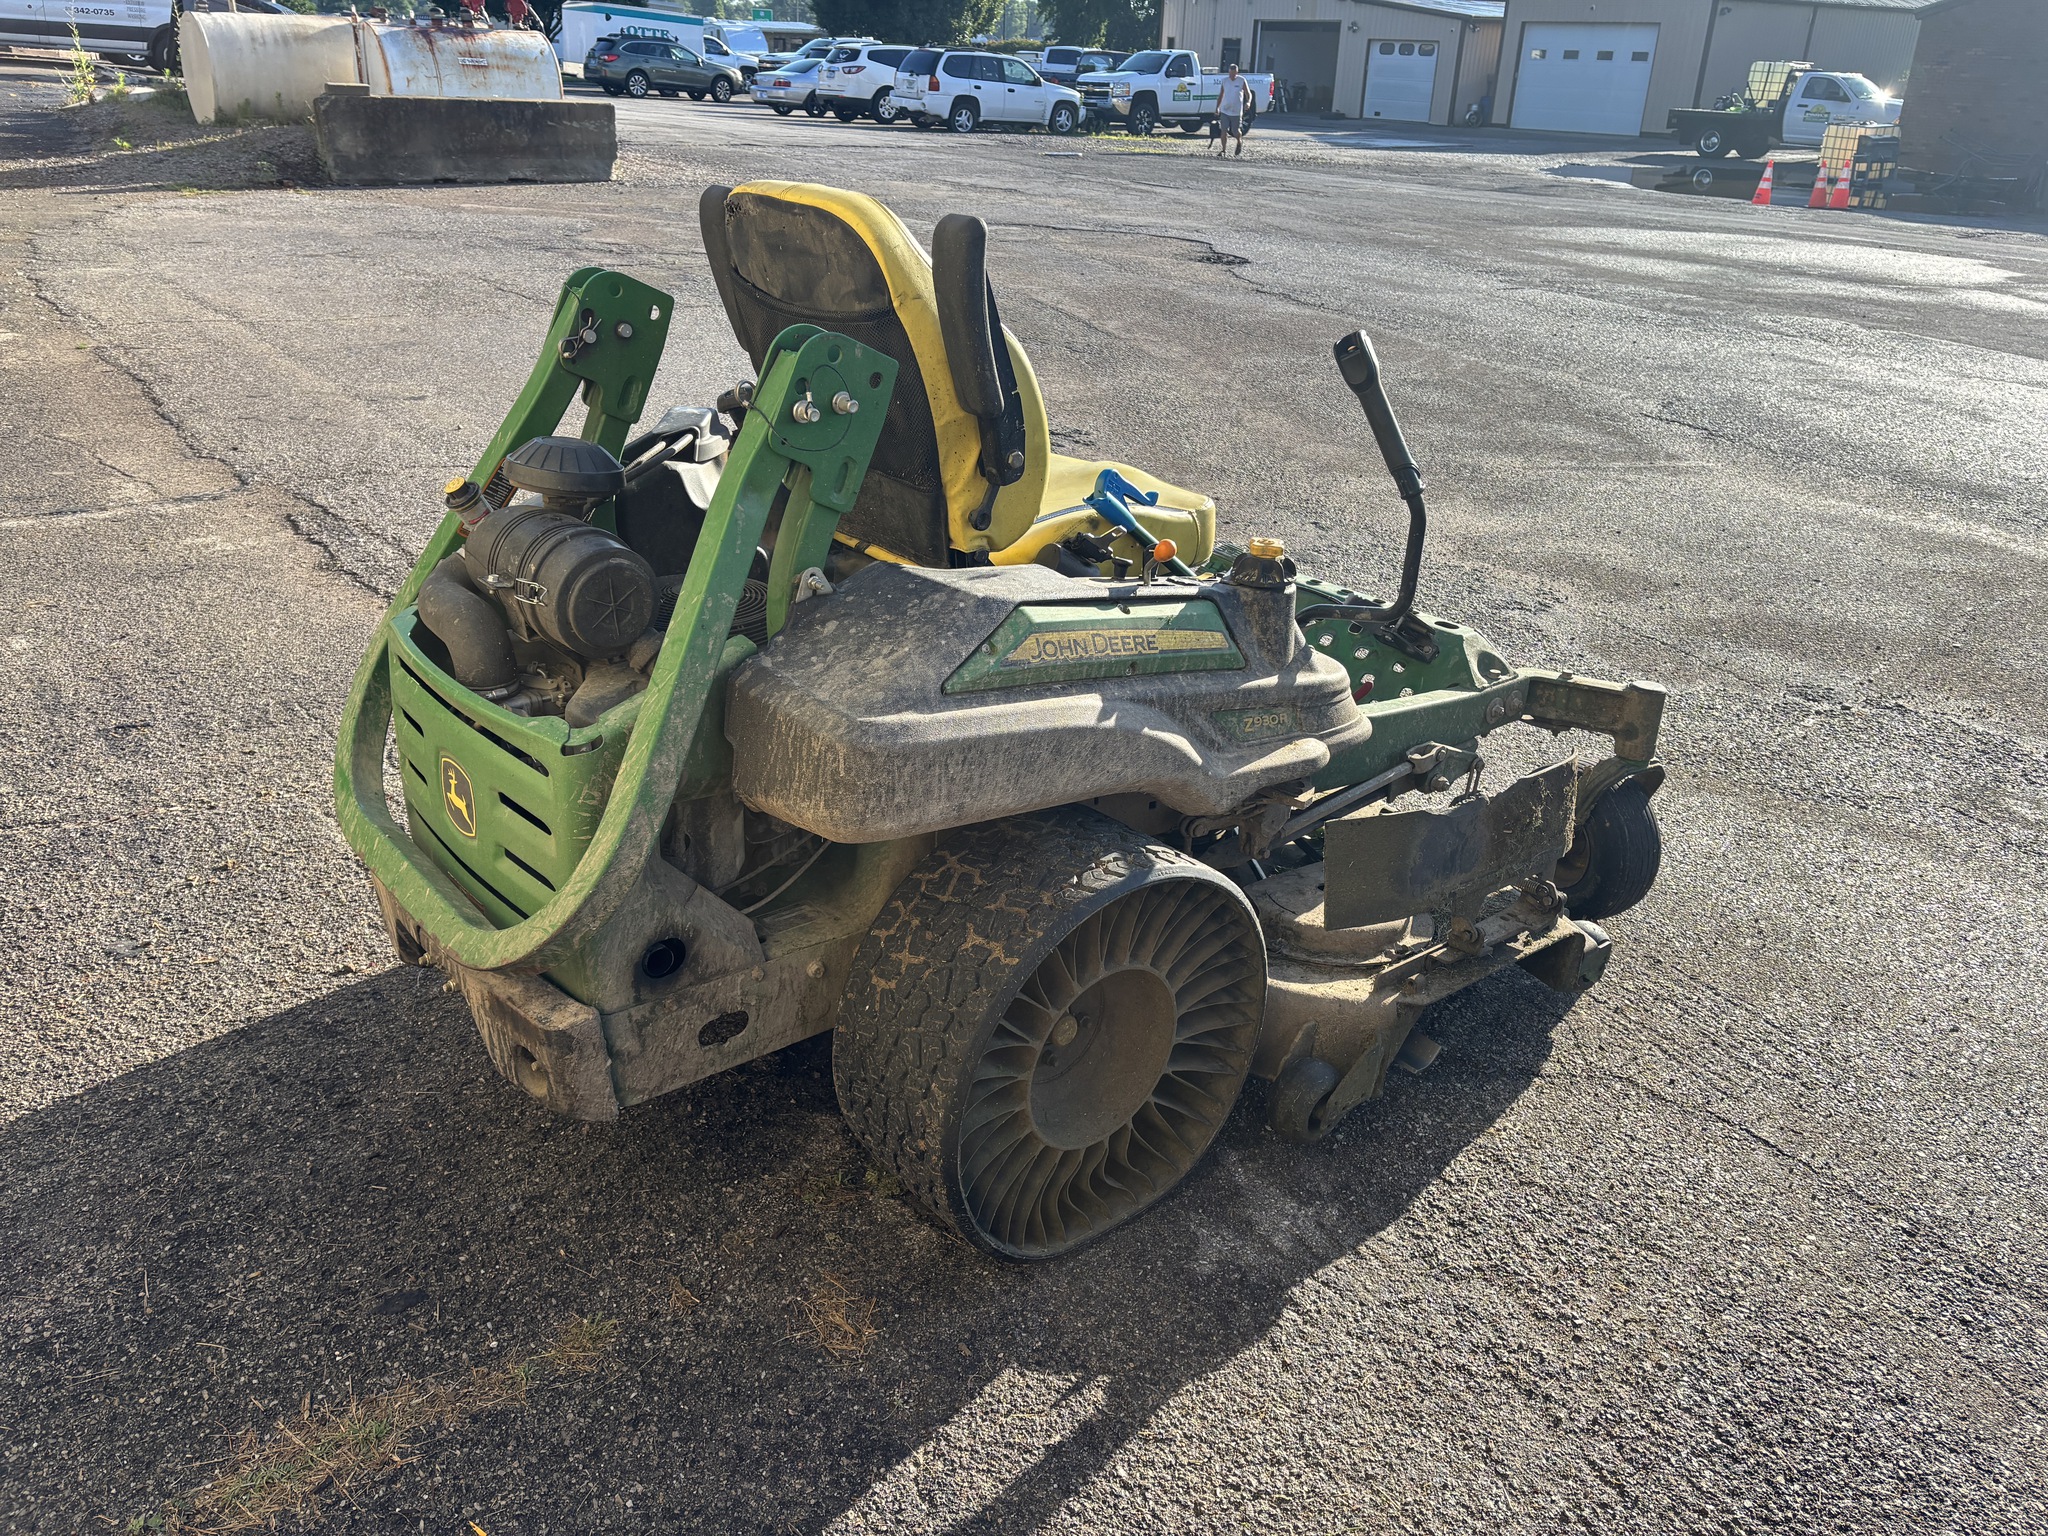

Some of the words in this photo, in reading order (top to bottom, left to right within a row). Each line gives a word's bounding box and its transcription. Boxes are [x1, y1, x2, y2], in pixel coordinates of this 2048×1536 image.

[73, 6, 115, 16] 342-0735
[1030, 637, 1090, 660] JOHN
[1091, 633, 1159, 654] DEERE
[1243, 713, 1288, 733] Z930R
